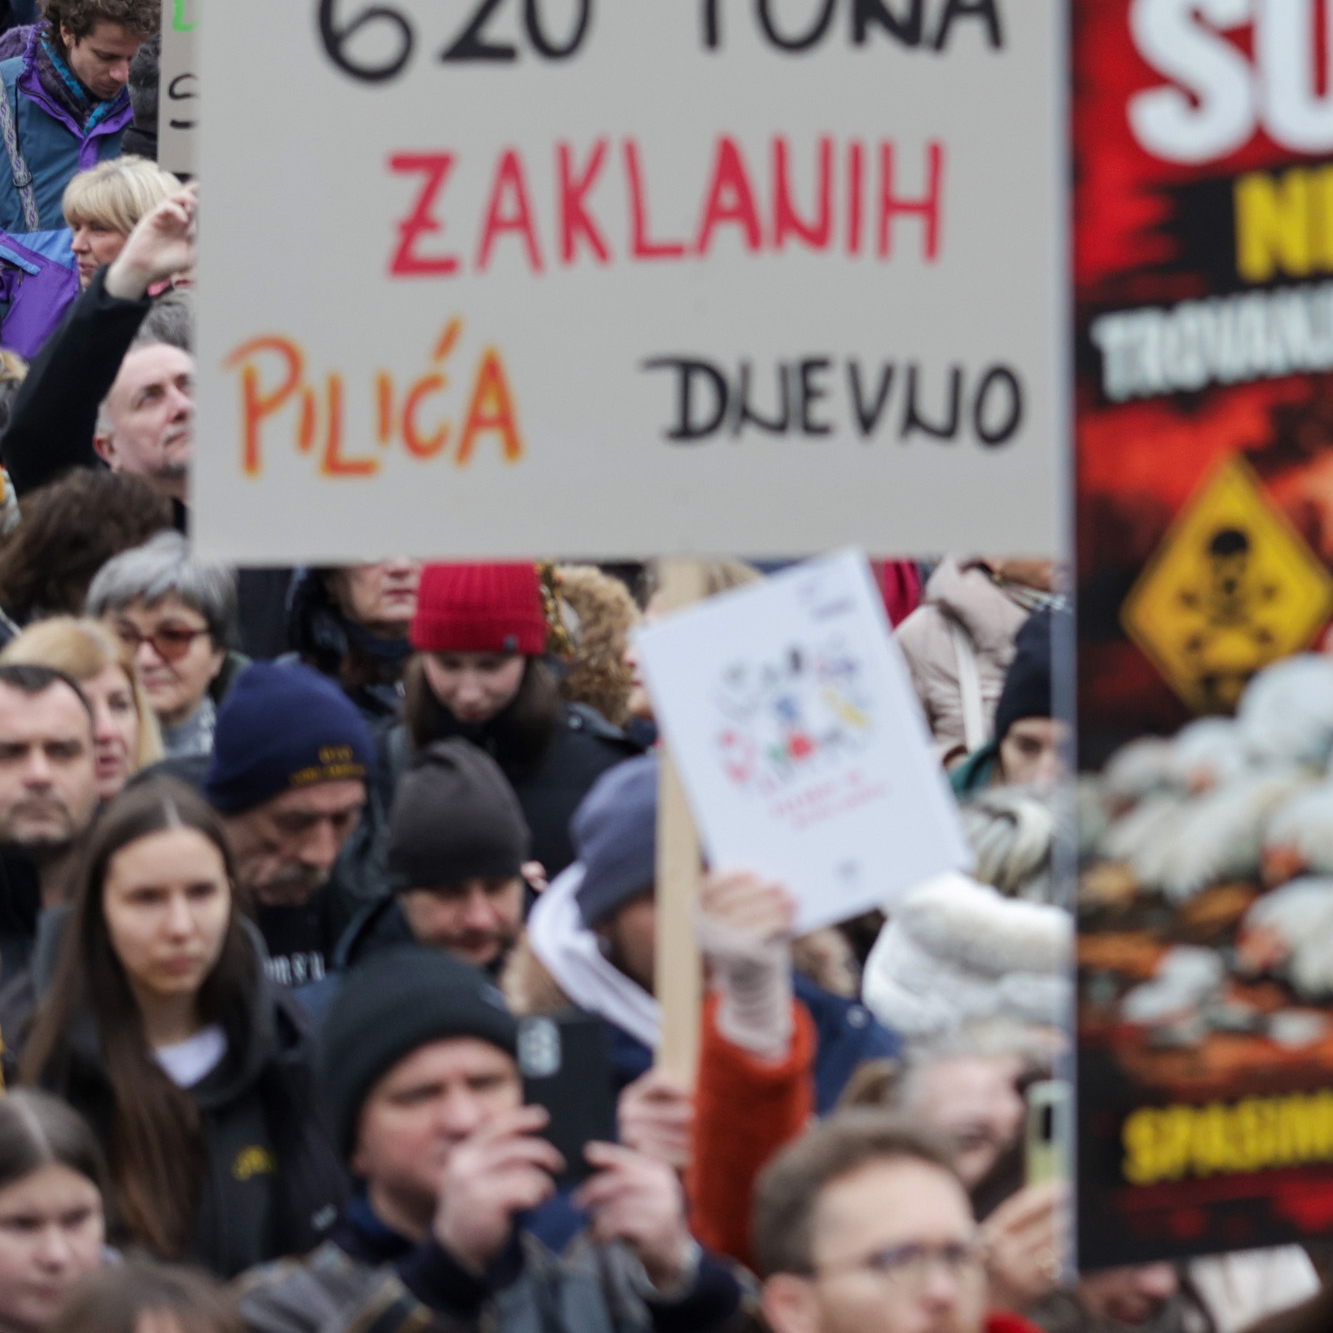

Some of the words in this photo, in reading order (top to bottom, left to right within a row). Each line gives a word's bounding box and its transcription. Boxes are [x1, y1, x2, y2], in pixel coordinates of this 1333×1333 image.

[386, 131, 946, 278] ZAKLANIH
[222, 315, 522, 478] PILIĆA
[638, 354, 1025, 449] DNEVNO
